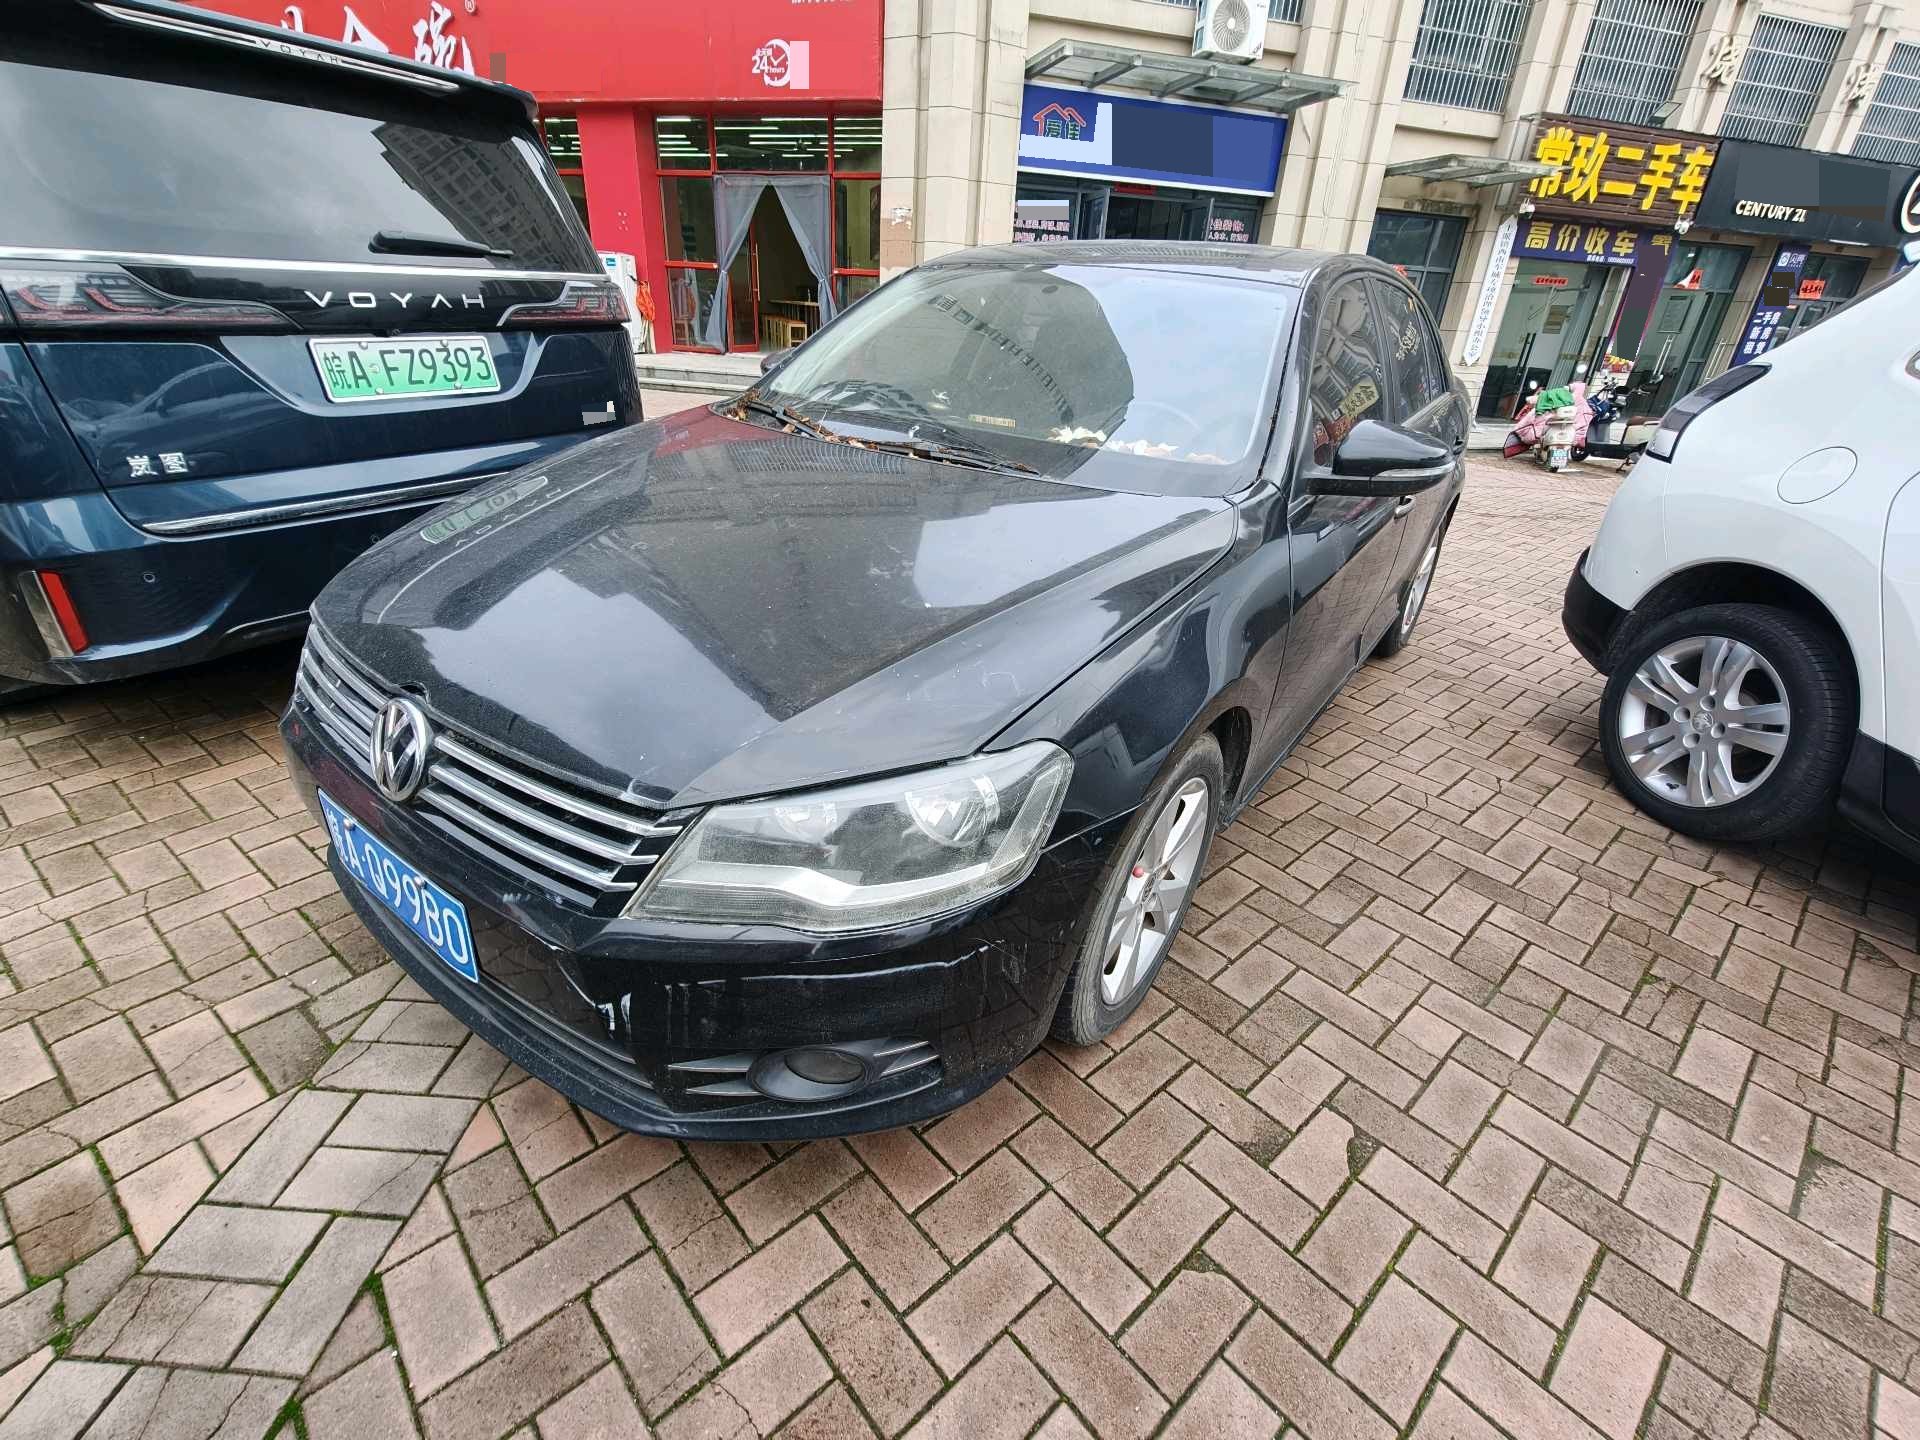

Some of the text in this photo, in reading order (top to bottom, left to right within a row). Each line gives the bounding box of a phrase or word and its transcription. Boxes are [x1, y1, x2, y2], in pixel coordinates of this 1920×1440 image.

[261, 40, 341, 64] VOYAH
[752, 55, 769, 74] 24
[1529, 126, 1717, 215] 常玖二手车
[1735, 199, 1795, 221] CENTURY
[1524, 221, 1639, 257] 高价收车
[304, 290, 486, 309] VOYAH
[1753, 311, 1782, 325] 二手房
[126, 453, 189, 478] 岚图
